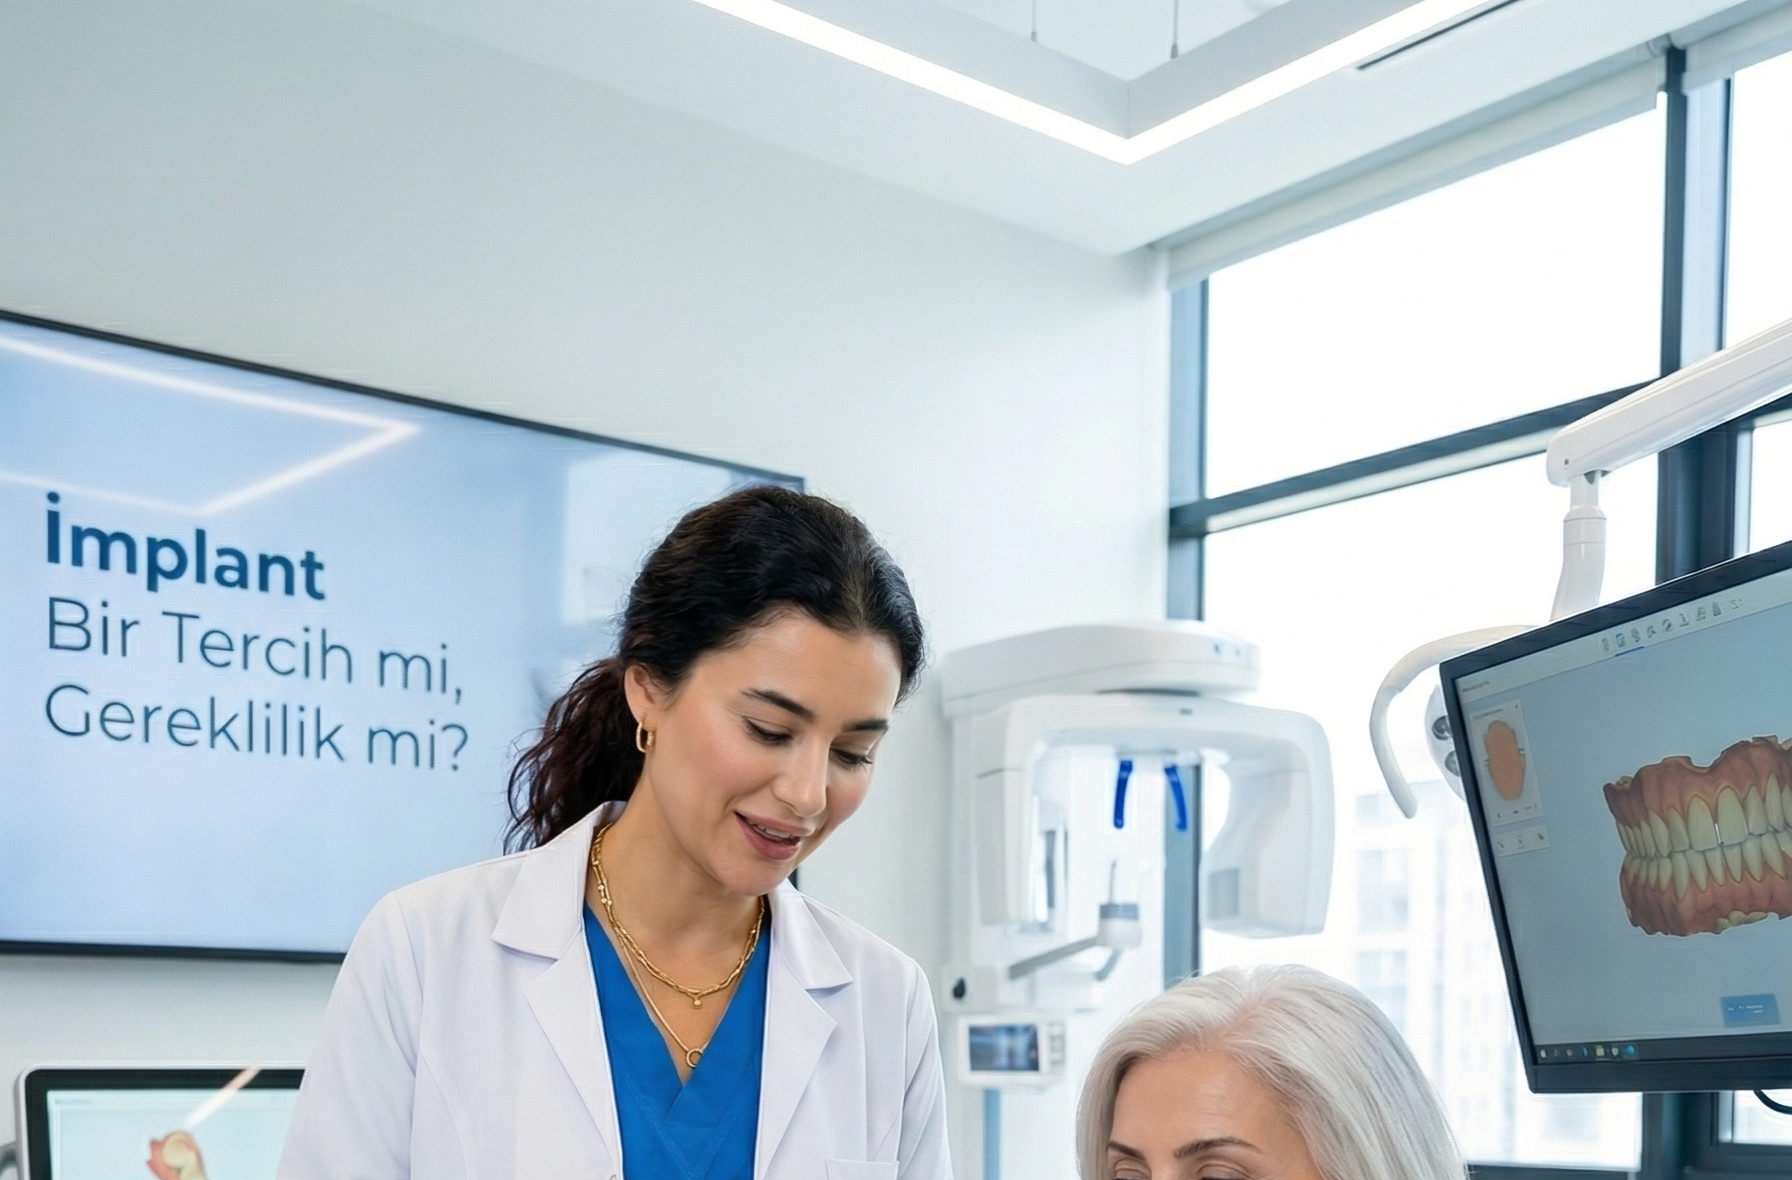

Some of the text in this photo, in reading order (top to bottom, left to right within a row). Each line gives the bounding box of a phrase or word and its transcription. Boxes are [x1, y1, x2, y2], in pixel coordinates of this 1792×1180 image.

[46, 491, 325, 601] İmplant
[48, 596, 463, 706] Bir Tercih mi,
[44, 683, 469, 772] Gereklilik mi?
